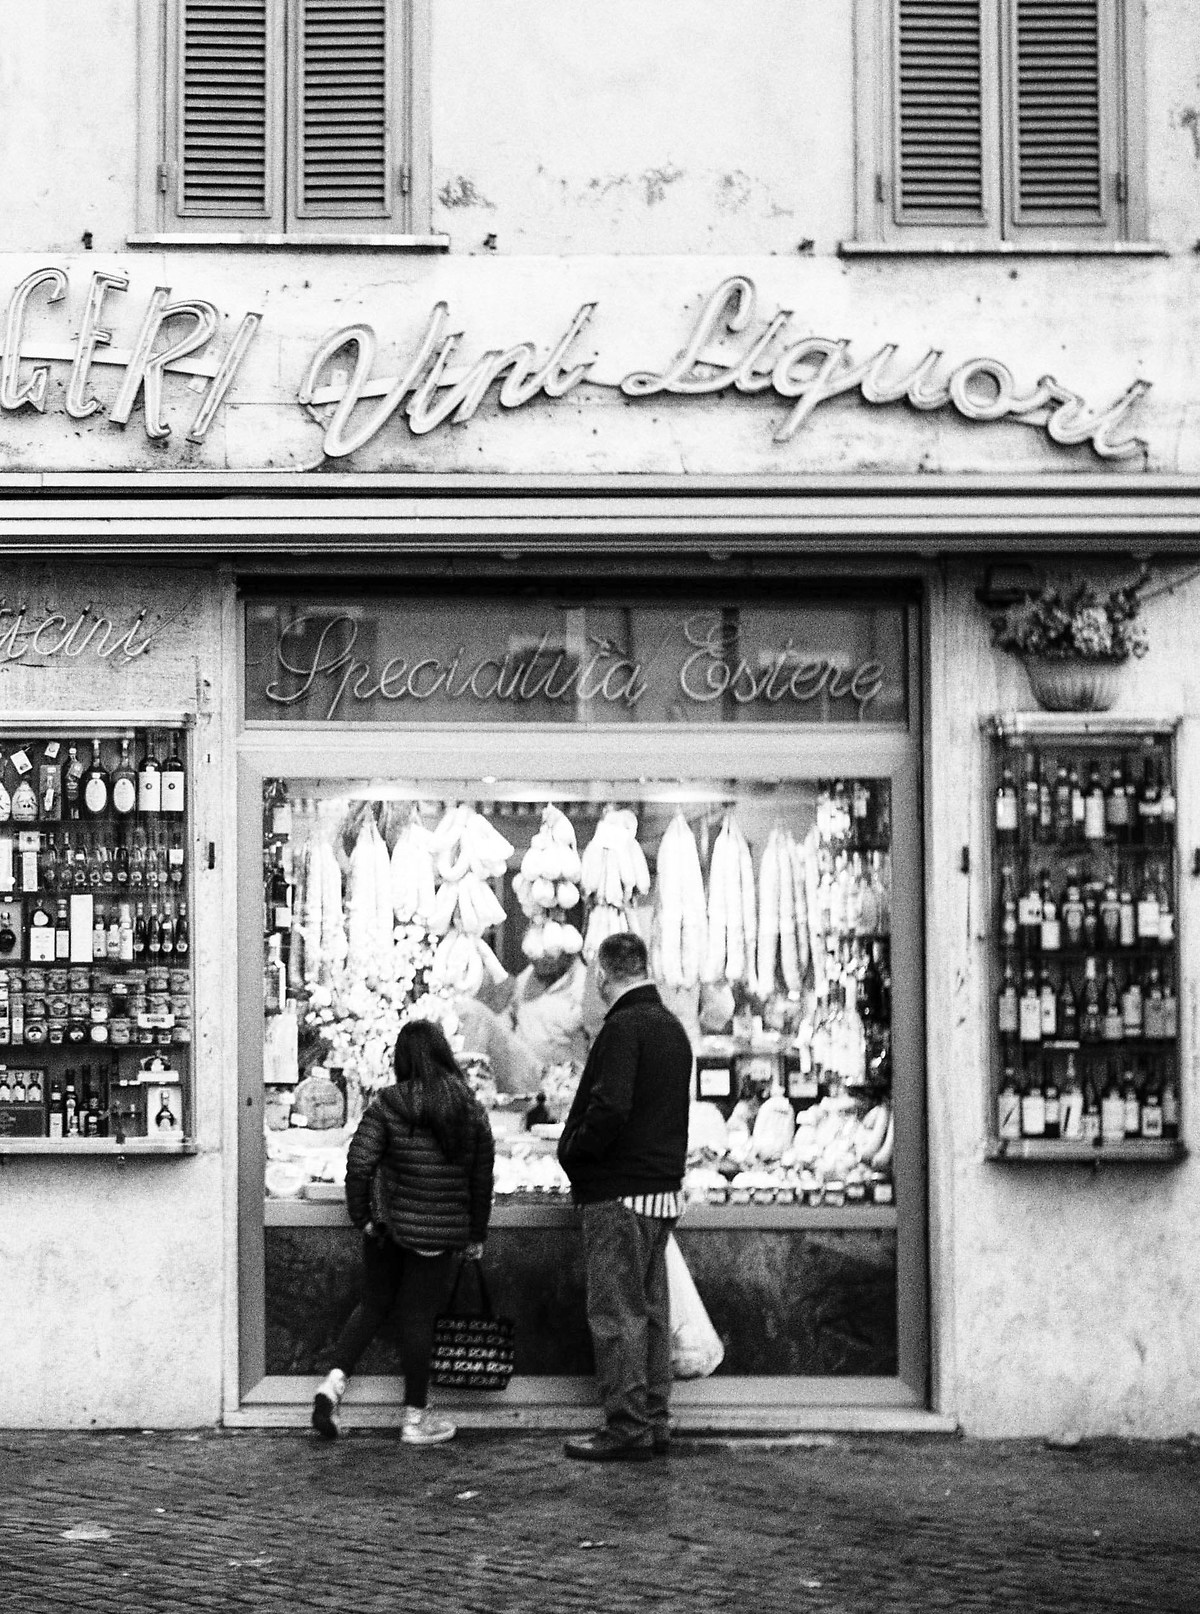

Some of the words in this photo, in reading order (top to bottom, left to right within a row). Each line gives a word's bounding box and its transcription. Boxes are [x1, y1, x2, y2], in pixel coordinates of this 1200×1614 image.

[298, 301, 598, 458] Vini
[621, 275, 1154, 460] Liquori
[681, 614, 886, 702] Estere
